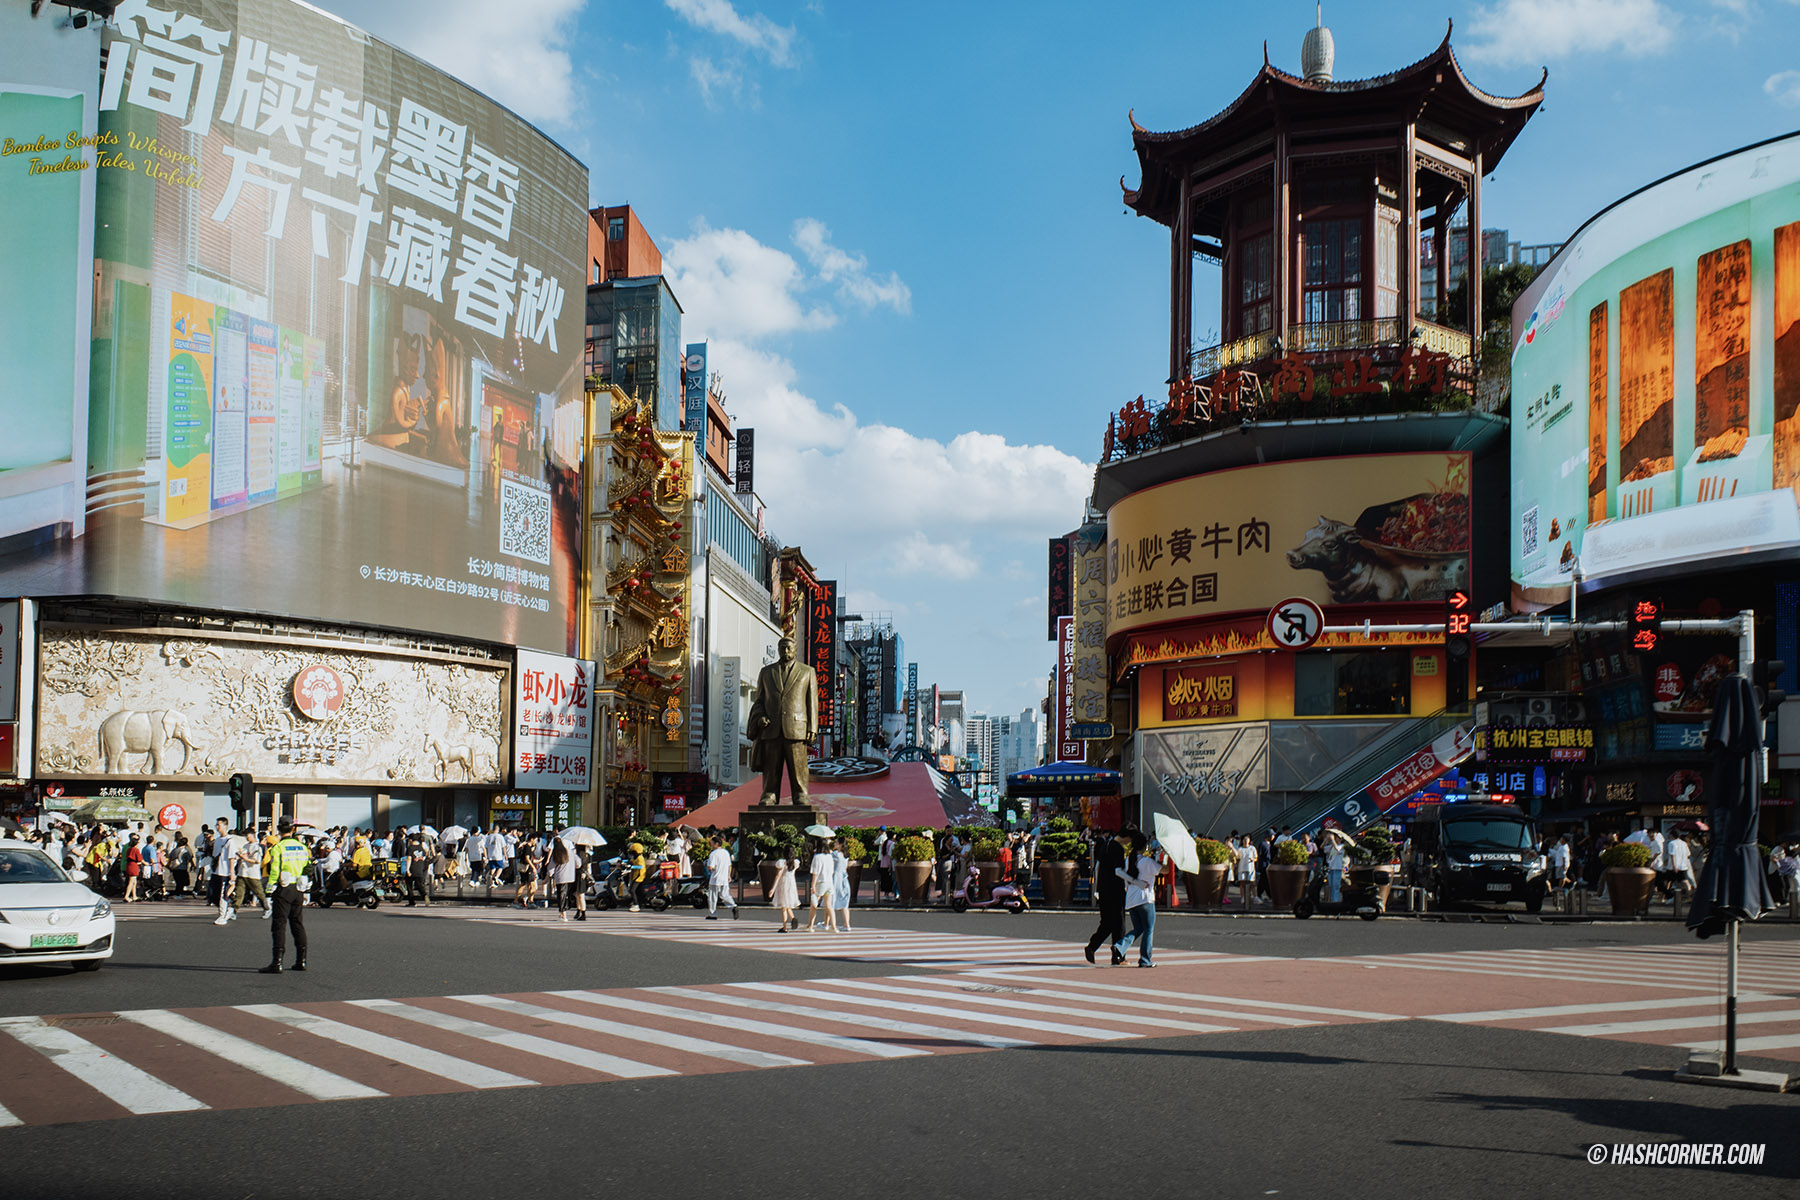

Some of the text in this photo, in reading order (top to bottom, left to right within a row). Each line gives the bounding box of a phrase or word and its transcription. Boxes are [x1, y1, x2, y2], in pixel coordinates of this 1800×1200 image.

[99, 0, 520, 242] 简牍载墨香
[2, 136, 60, 156] Bamboo
[65, 131, 120, 149] Scripts
[28, 151, 205, 189] Timeless Tales Unfold
[211, 144, 565, 353] 方寸藏春秋
[1103, 343, 1450, 462] 路步行商业街
[467, 557, 550, 592] 长沙简牍博物馆
[1077, 557, 1106, 719] 周六福珠宝
[1449, 614, 1468, 634] 32
[523, 664, 587, 709] 虾小龙
[1658, 668, 1681, 696] 非遗
[1176, 704, 1233, 718] 小炒黄牛肉
[1065, 745, 1077, 754] 3F
[1493, 729, 1594, 748] 杭州宝岛眼镜
[520, 752, 586, 777] 季季红火锅
[1352, 811, 1368, 827] 2F
